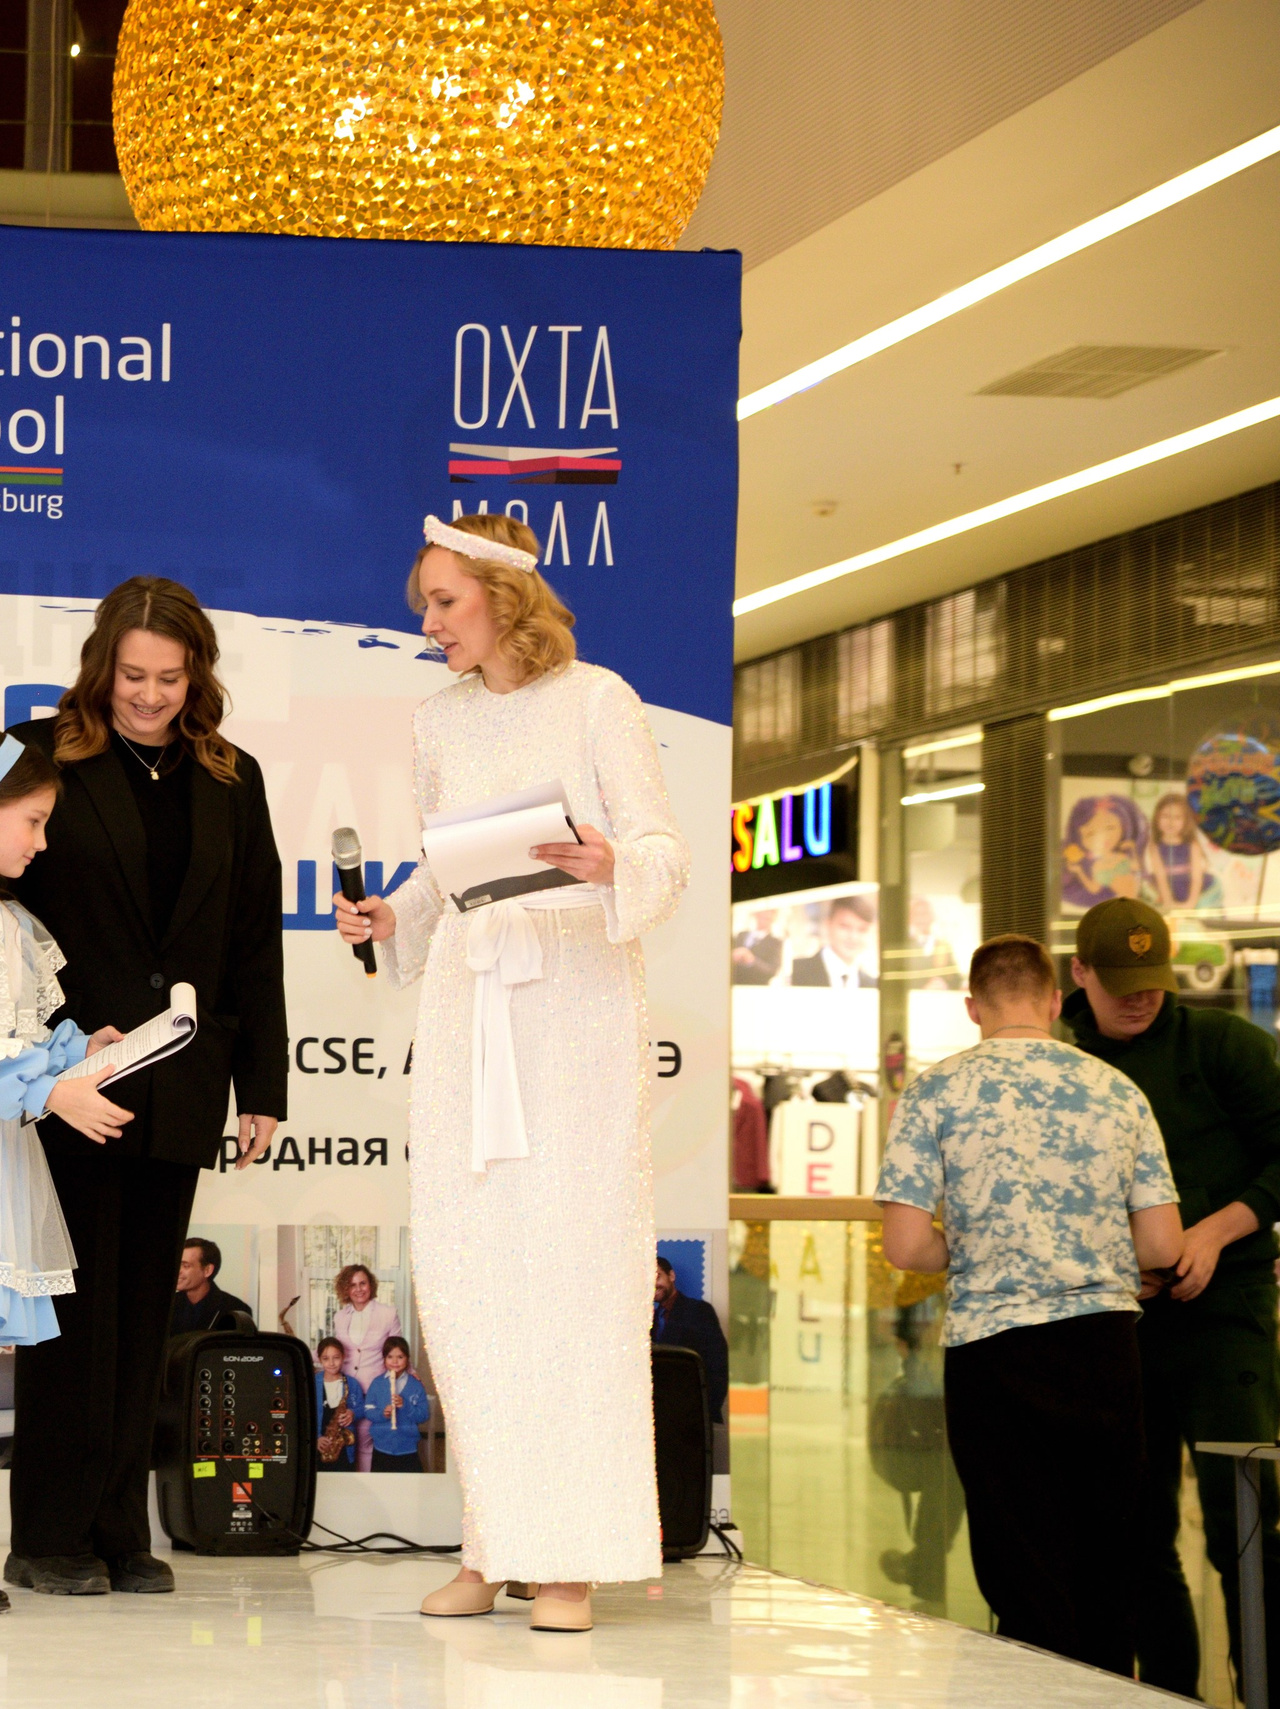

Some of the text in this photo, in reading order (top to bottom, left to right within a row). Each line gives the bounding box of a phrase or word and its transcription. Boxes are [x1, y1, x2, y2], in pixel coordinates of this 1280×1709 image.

[453, 323, 619, 430] ОХТА
[730, 782, 832, 873] SALU
[287, 1036, 387, 1080] CSE,
[219, 1135, 388, 1173] родная
